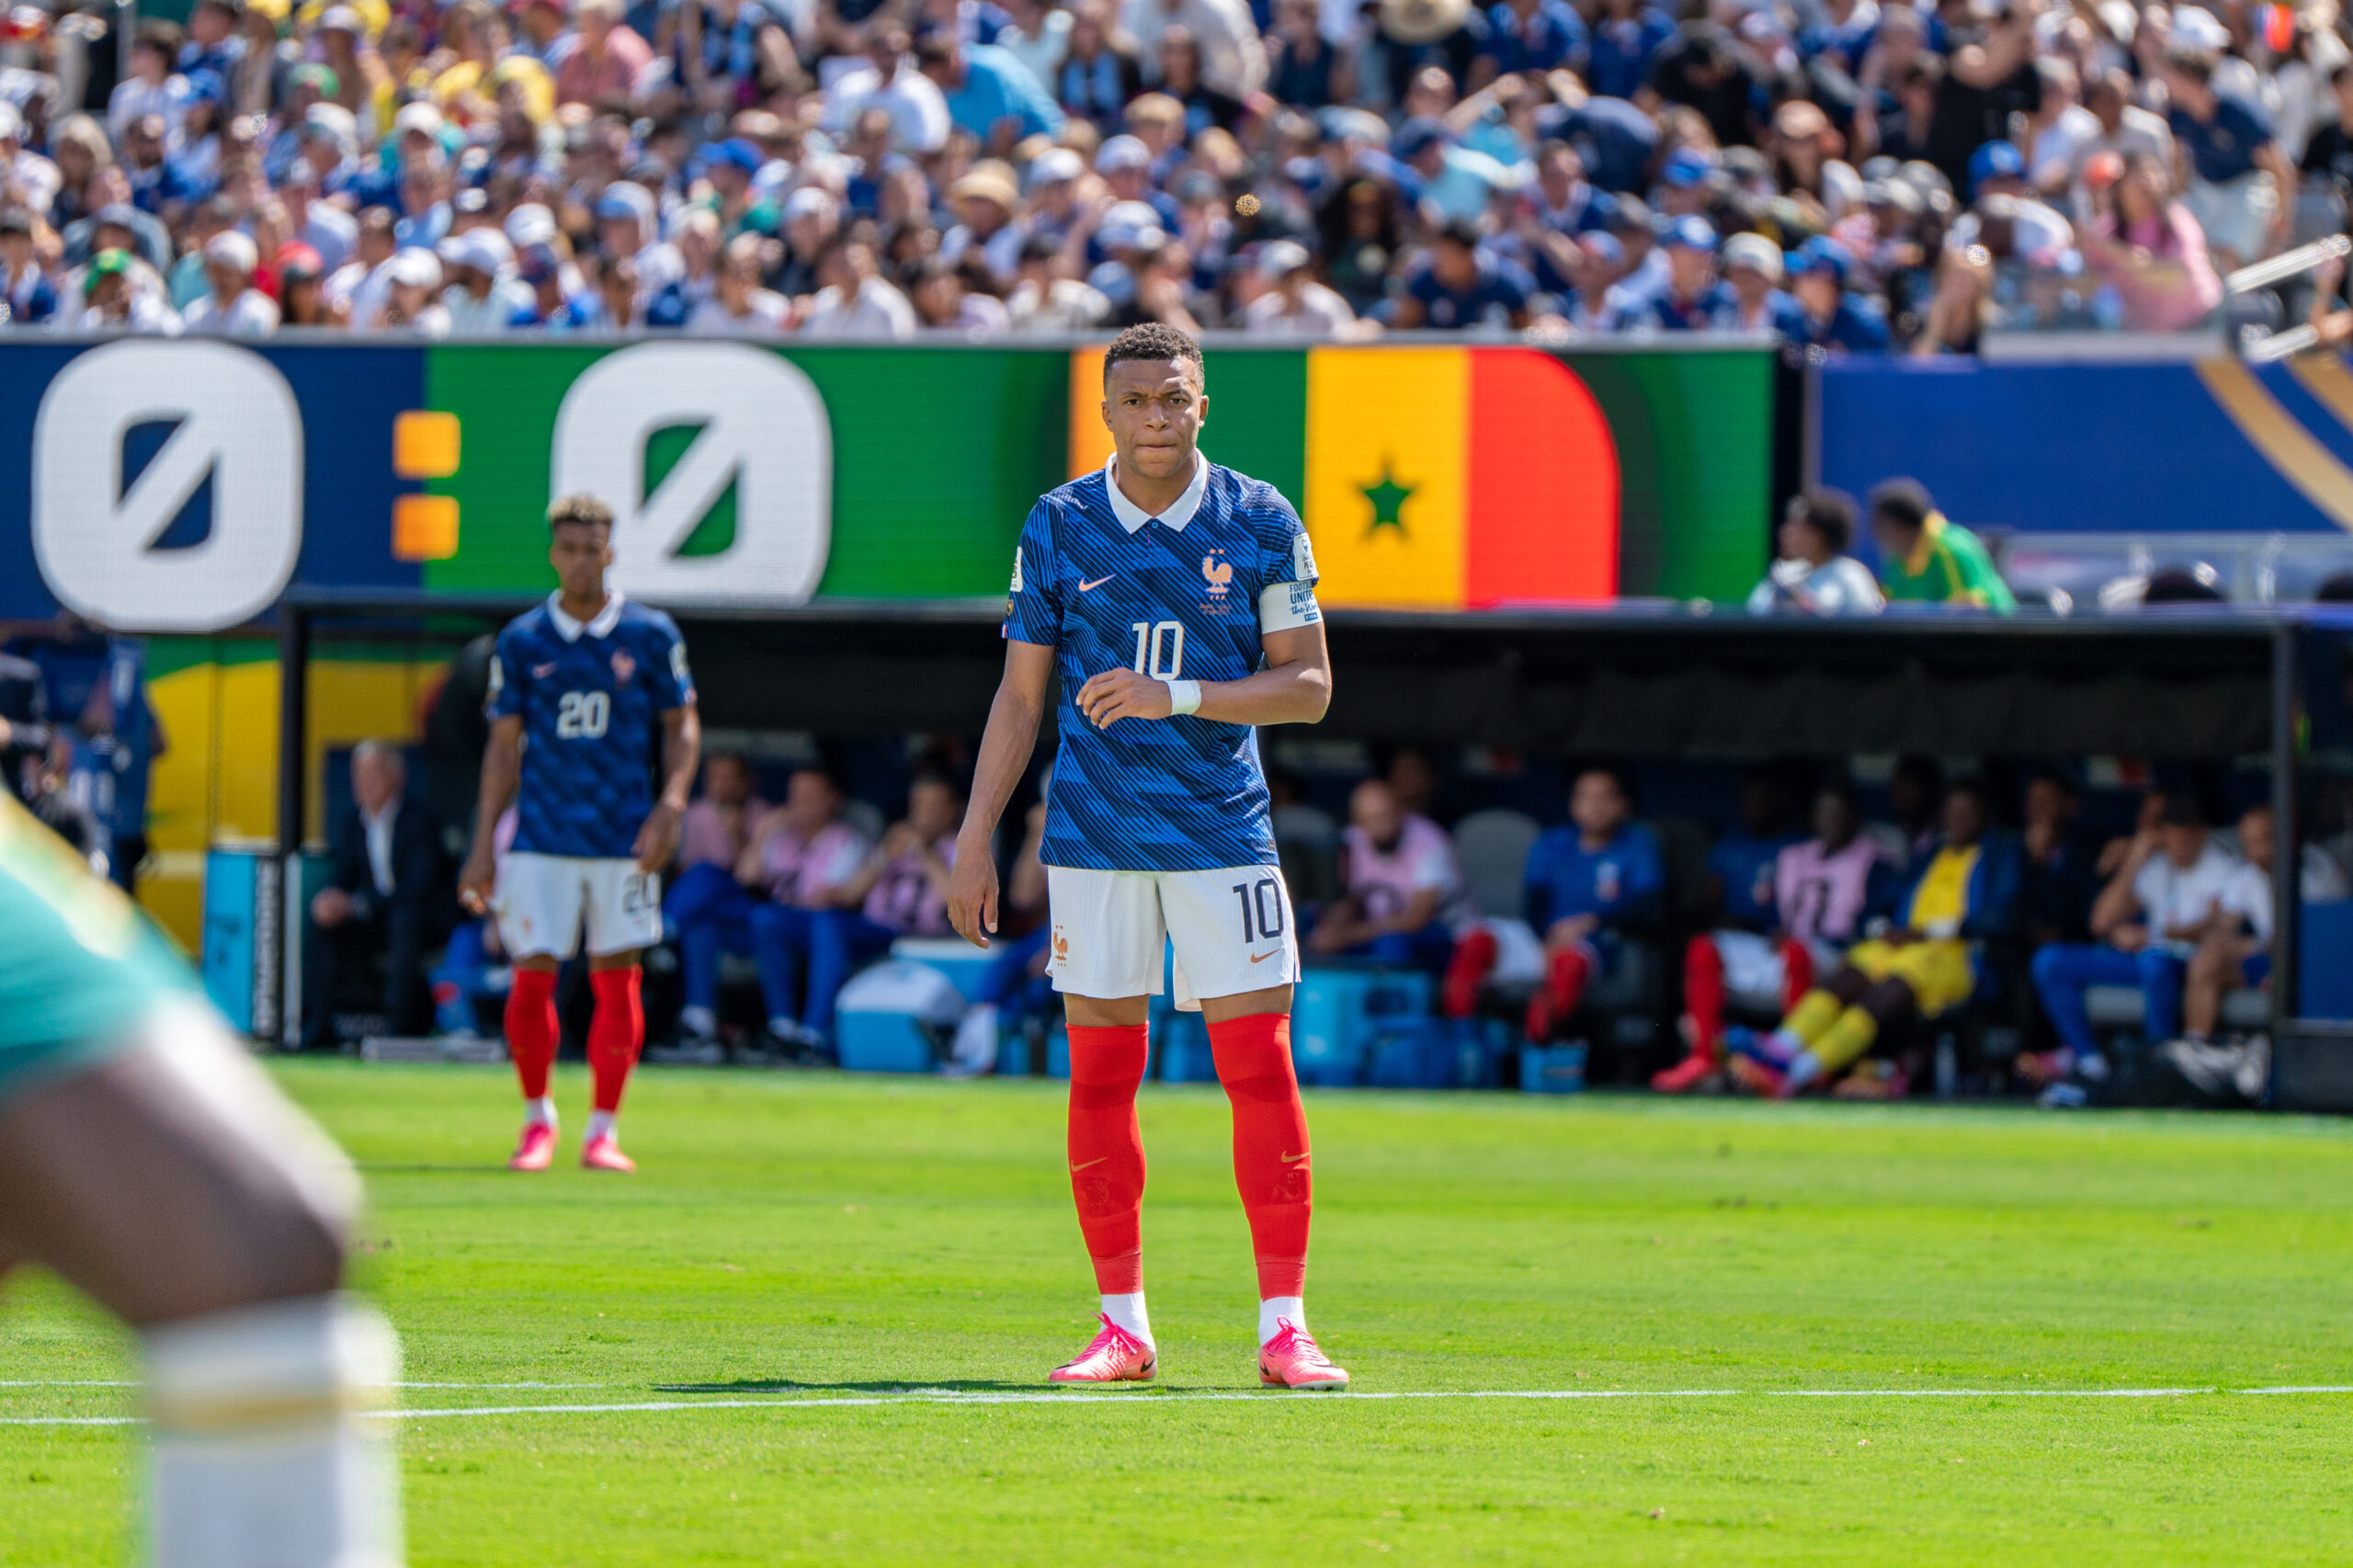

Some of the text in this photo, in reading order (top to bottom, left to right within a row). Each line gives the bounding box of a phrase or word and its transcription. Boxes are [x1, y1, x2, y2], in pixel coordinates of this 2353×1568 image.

[1290, 604, 1304, 615] the
[1131, 620, 1185, 681] 10
[556, 690, 610, 739] 20
[1232, 877, 1284, 944] 10
